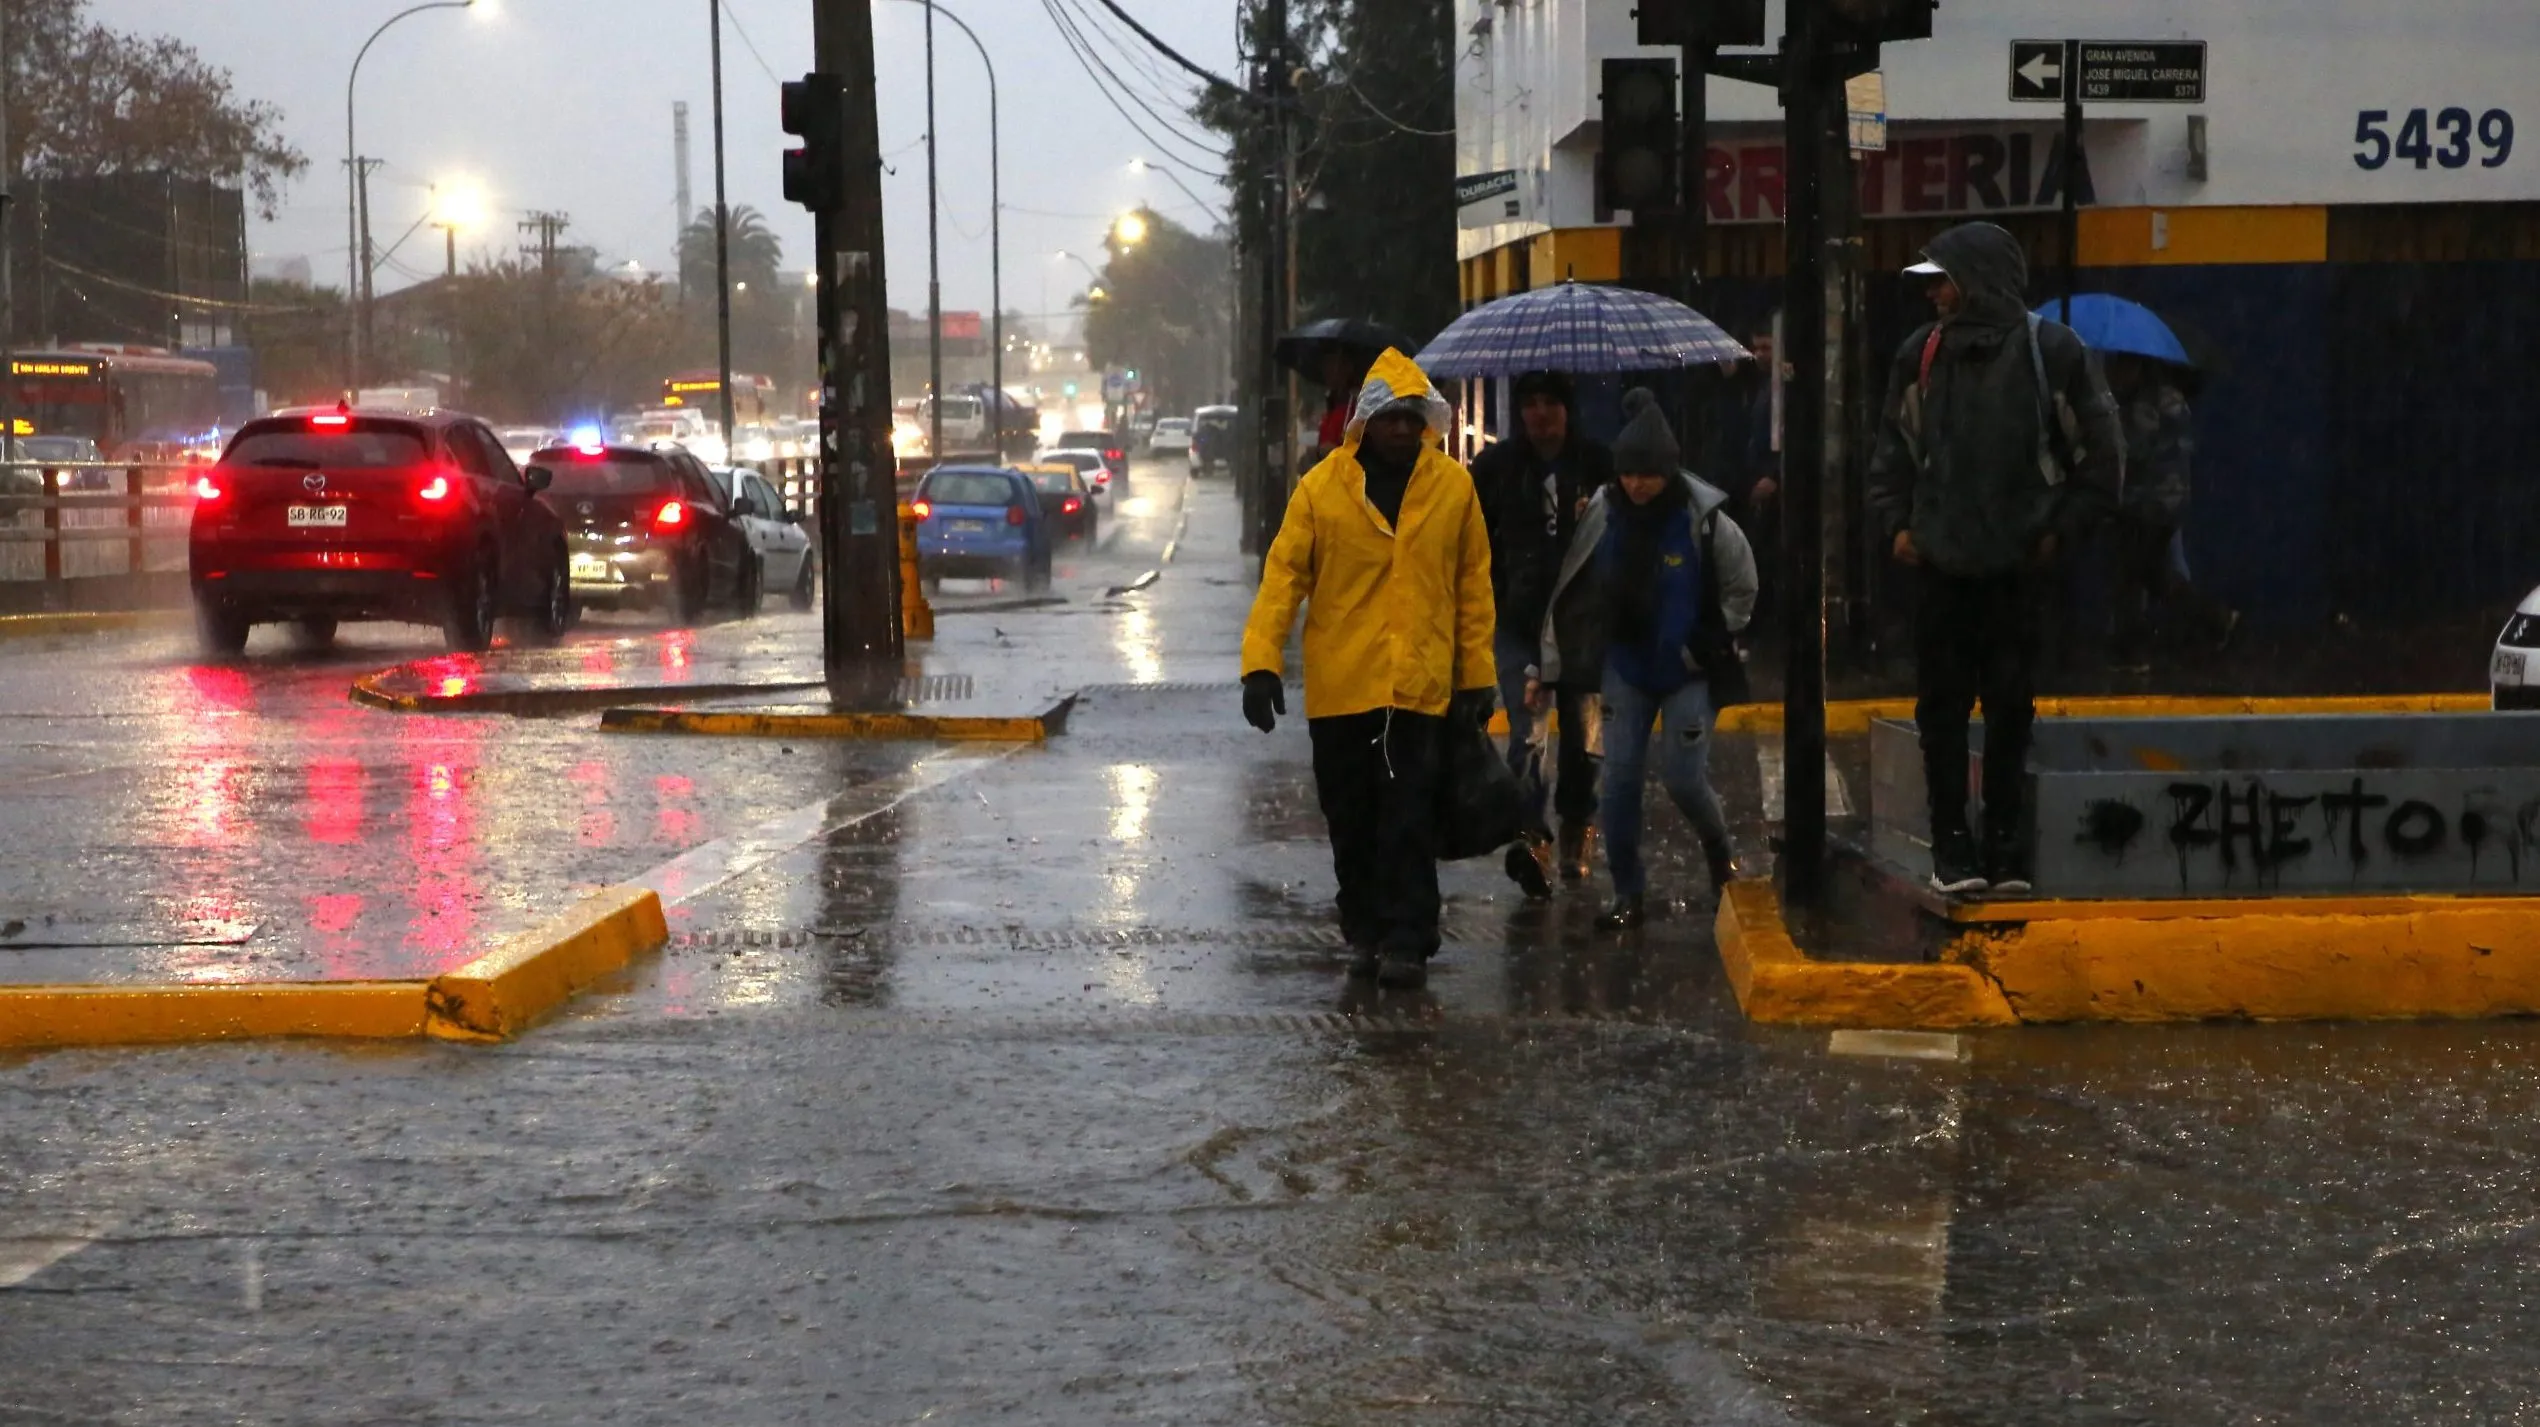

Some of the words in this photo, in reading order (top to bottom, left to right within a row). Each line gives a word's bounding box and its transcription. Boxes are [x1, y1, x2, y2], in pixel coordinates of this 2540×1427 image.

[2085, 49, 2113, 62] GRAN
[2115, 49, 2156, 62] AVENIDA
[2085, 67, 2111, 81] JOSE
[2113, 68, 2149, 81] MIGUEL
[2152, 68, 2200, 81] CARRERA
[2087, 83, 2110, 96] 5439
[2353, 106, 2514, 171] 5439
[1594, 132, 2097, 223] RRTERIA
